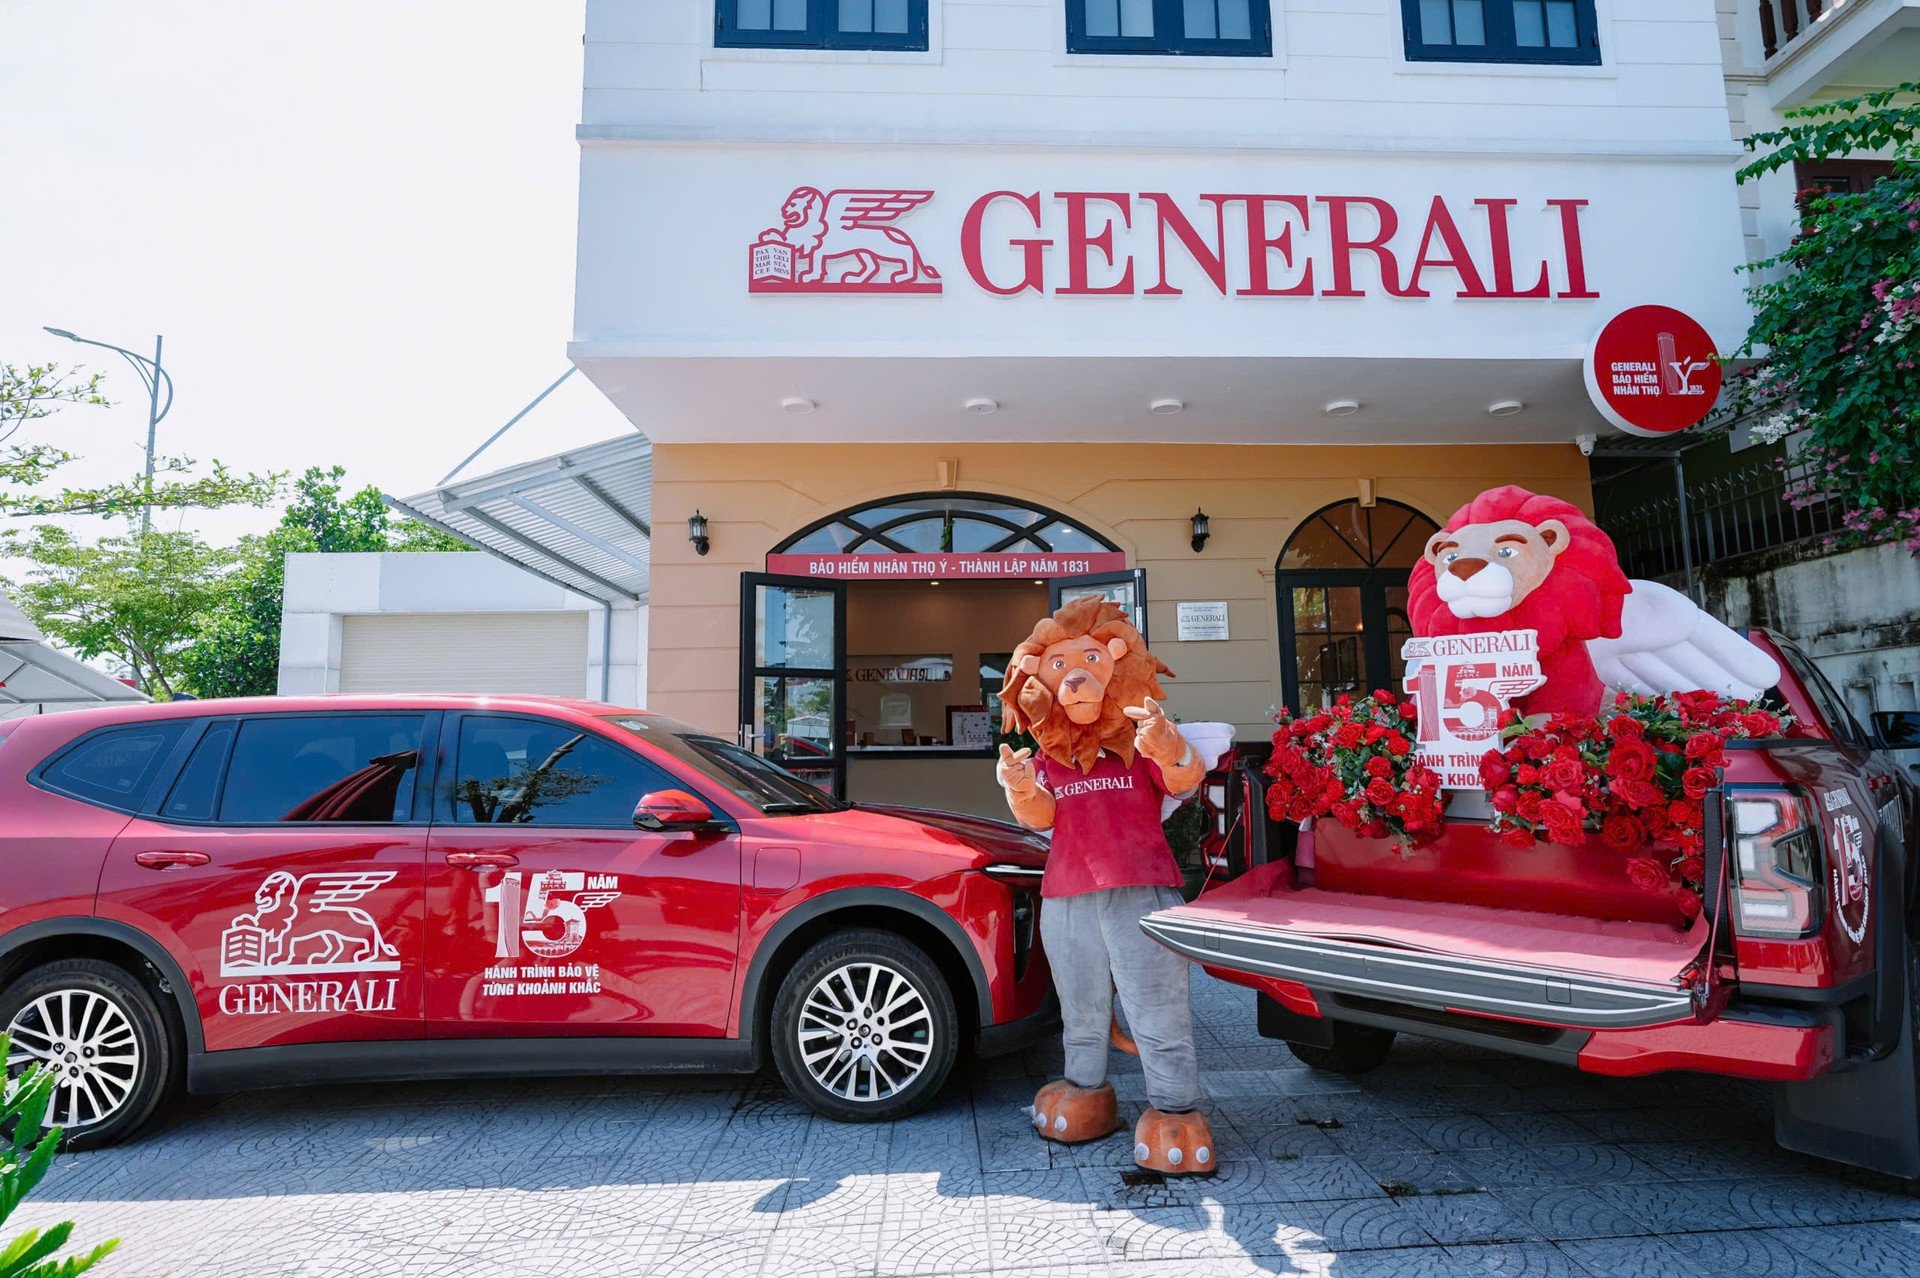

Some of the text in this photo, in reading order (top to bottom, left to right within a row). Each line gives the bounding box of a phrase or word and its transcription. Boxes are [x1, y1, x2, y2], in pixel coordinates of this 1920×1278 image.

[961, 190, 1600, 298] GENERALI
[1611, 362, 1656, 372] GENERALI
[1612, 372, 1632, 384] BẢO
[1613, 384, 1660, 397] NHÂN THỌ
[809, 558, 835, 575] BẢO
[838, 556, 870, 574] HIỂM
[873, 558, 908, 574] NHÂN
[911, 561, 936, 576] THỌ
[939, 558, 948, 573] Ý
[959, 558, 1001, 573] THÀNH
[1004, 557, 1027, 576] LẬP
[1030, 558, 1058, 573] NĂM
[1061, 560, 1090, 573] 1831
[1190, 614, 1225, 622] GENERALI
[1432, 633, 1532, 657] GENERALI
[1501, 662, 1533, 678] NĂM
[1448, 751, 1484, 767] TRÌN
[1064, 775, 1134, 797] GENERALI
[485, 870, 619, 958] 15 NĂM
[484, 962, 600, 979] HÀNH TRÌNH BẢO VỆ
[482, 977, 601, 996] TỪNG KHOẢNH KHẮC
[218, 978, 400, 1016] GENERALI
